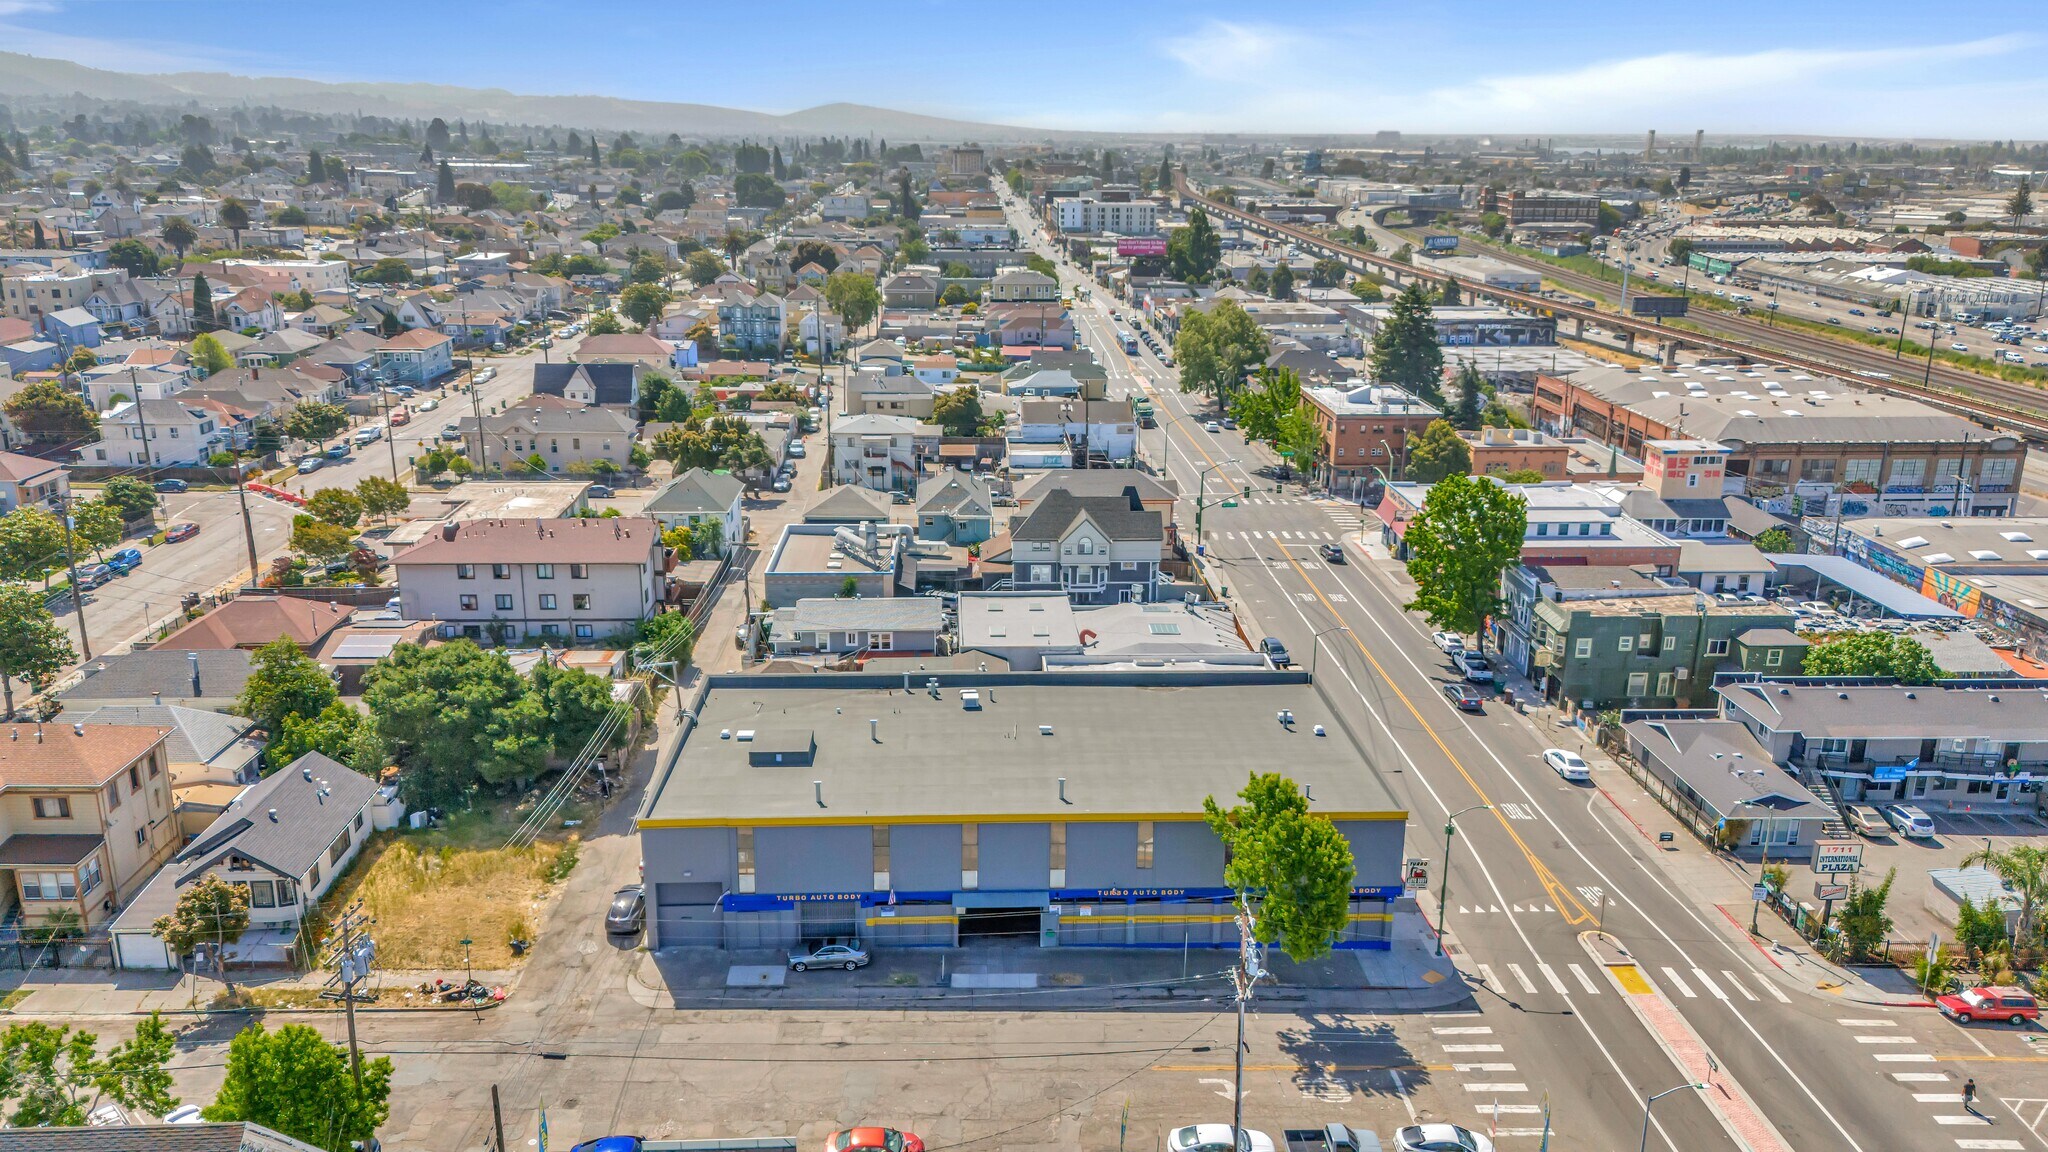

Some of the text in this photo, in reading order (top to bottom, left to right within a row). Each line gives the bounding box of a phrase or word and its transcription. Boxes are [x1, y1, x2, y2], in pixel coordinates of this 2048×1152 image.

[1475, 327, 1553, 345] KTM
[1300, 561, 1322, 570] ONLY
[1328, 593, 1348, 602] BUS
[1500, 803, 1538, 820] ONLY
[1819, 855, 1858, 863] INTERNATIONAL
[1821, 863, 1854, 872] PLAZA
